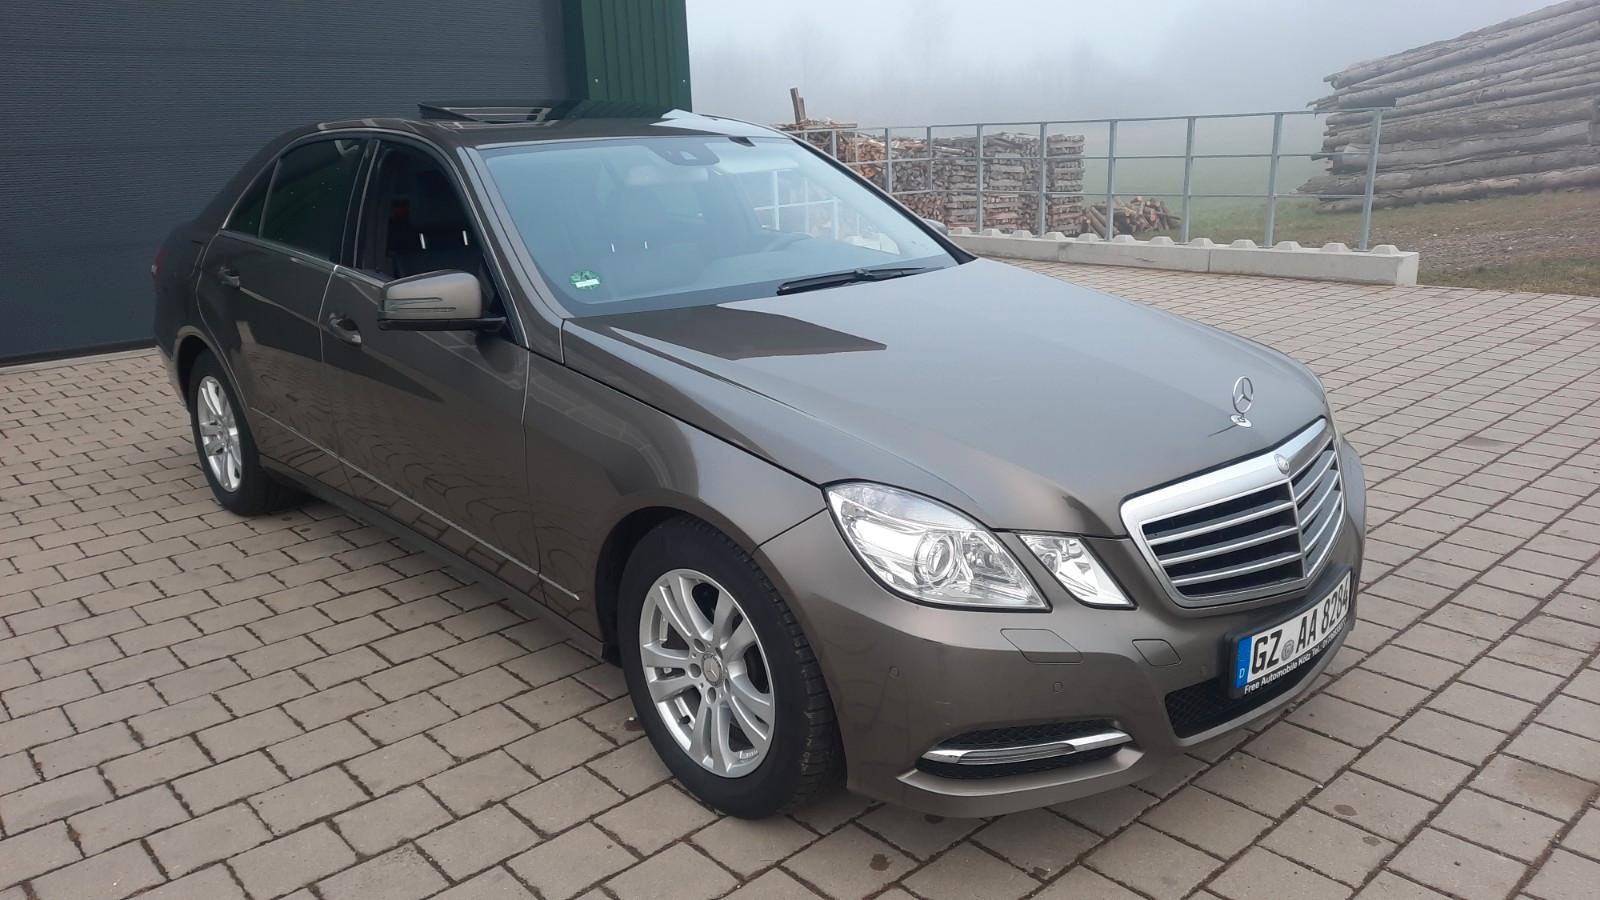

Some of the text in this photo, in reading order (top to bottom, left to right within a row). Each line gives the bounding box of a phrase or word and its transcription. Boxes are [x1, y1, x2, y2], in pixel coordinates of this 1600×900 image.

[1252, 629, 1283, 674] GZ
[1296, 608, 1318, 654] AA
[1321, 577, 1349, 635] 8284
[1239, 668, 1245, 679] D
[1244, 681, 1260, 695] Free
[1261, 661, 1298, 687] Automobile
